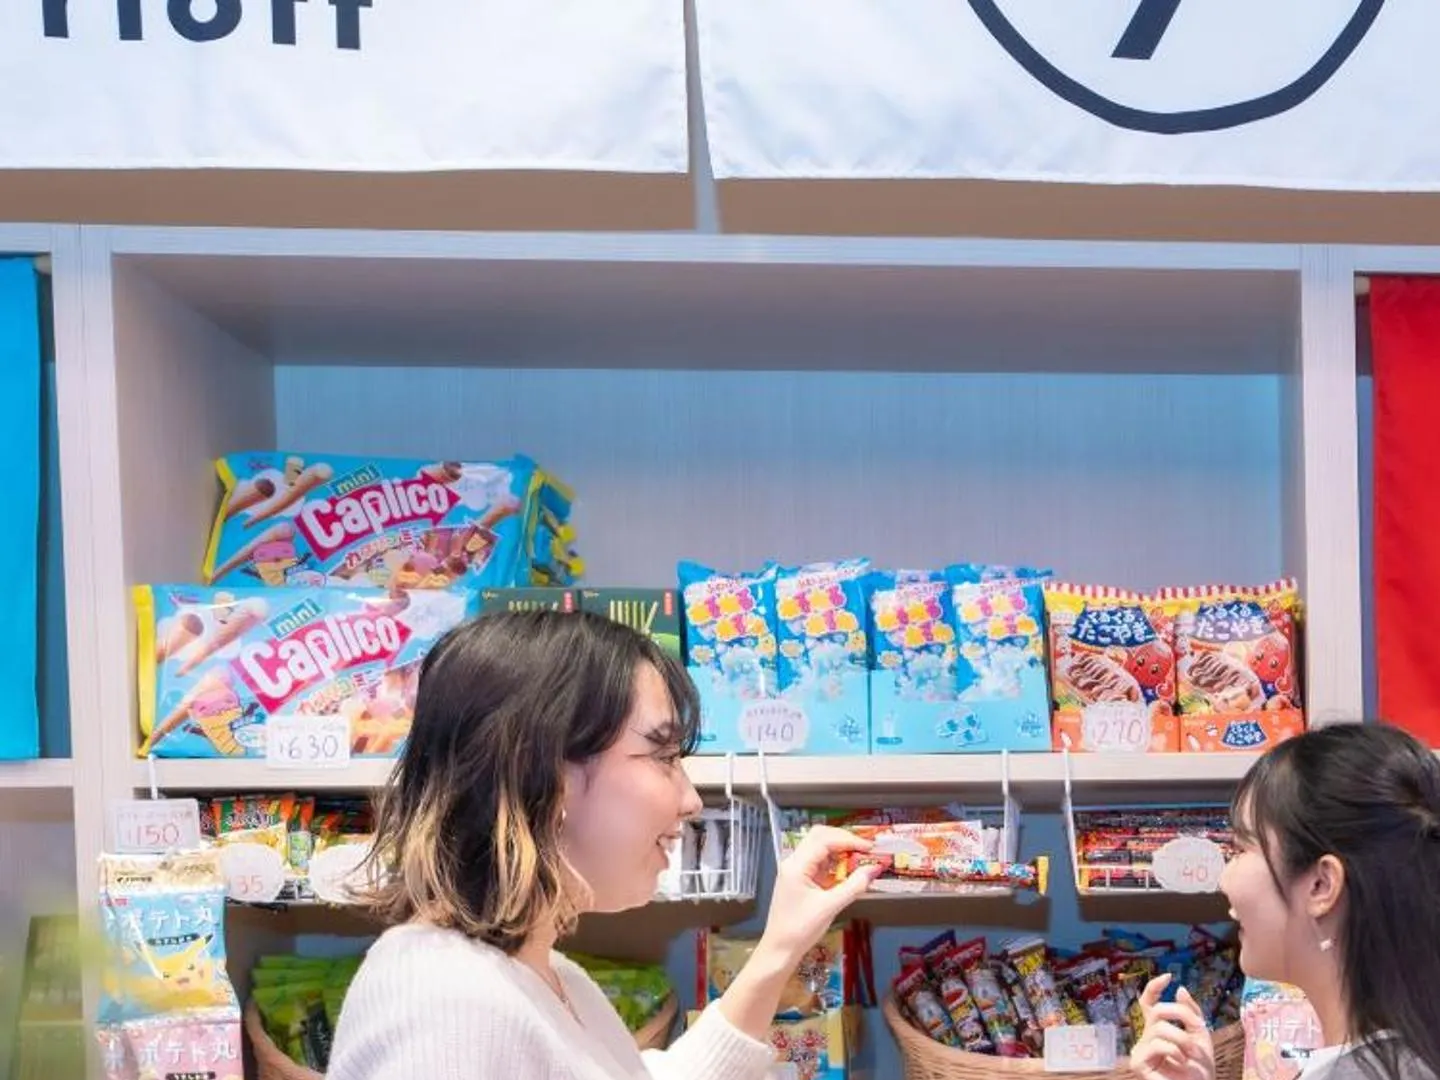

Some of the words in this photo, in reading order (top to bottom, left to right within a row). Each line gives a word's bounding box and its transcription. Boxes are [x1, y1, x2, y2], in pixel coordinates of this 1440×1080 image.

[302, 478, 449, 550] Caplico
[1078, 620, 1152, 643] たこやき
[1198, 615, 1266, 638] たこやき
[241, 614, 401, 699] Caplico
